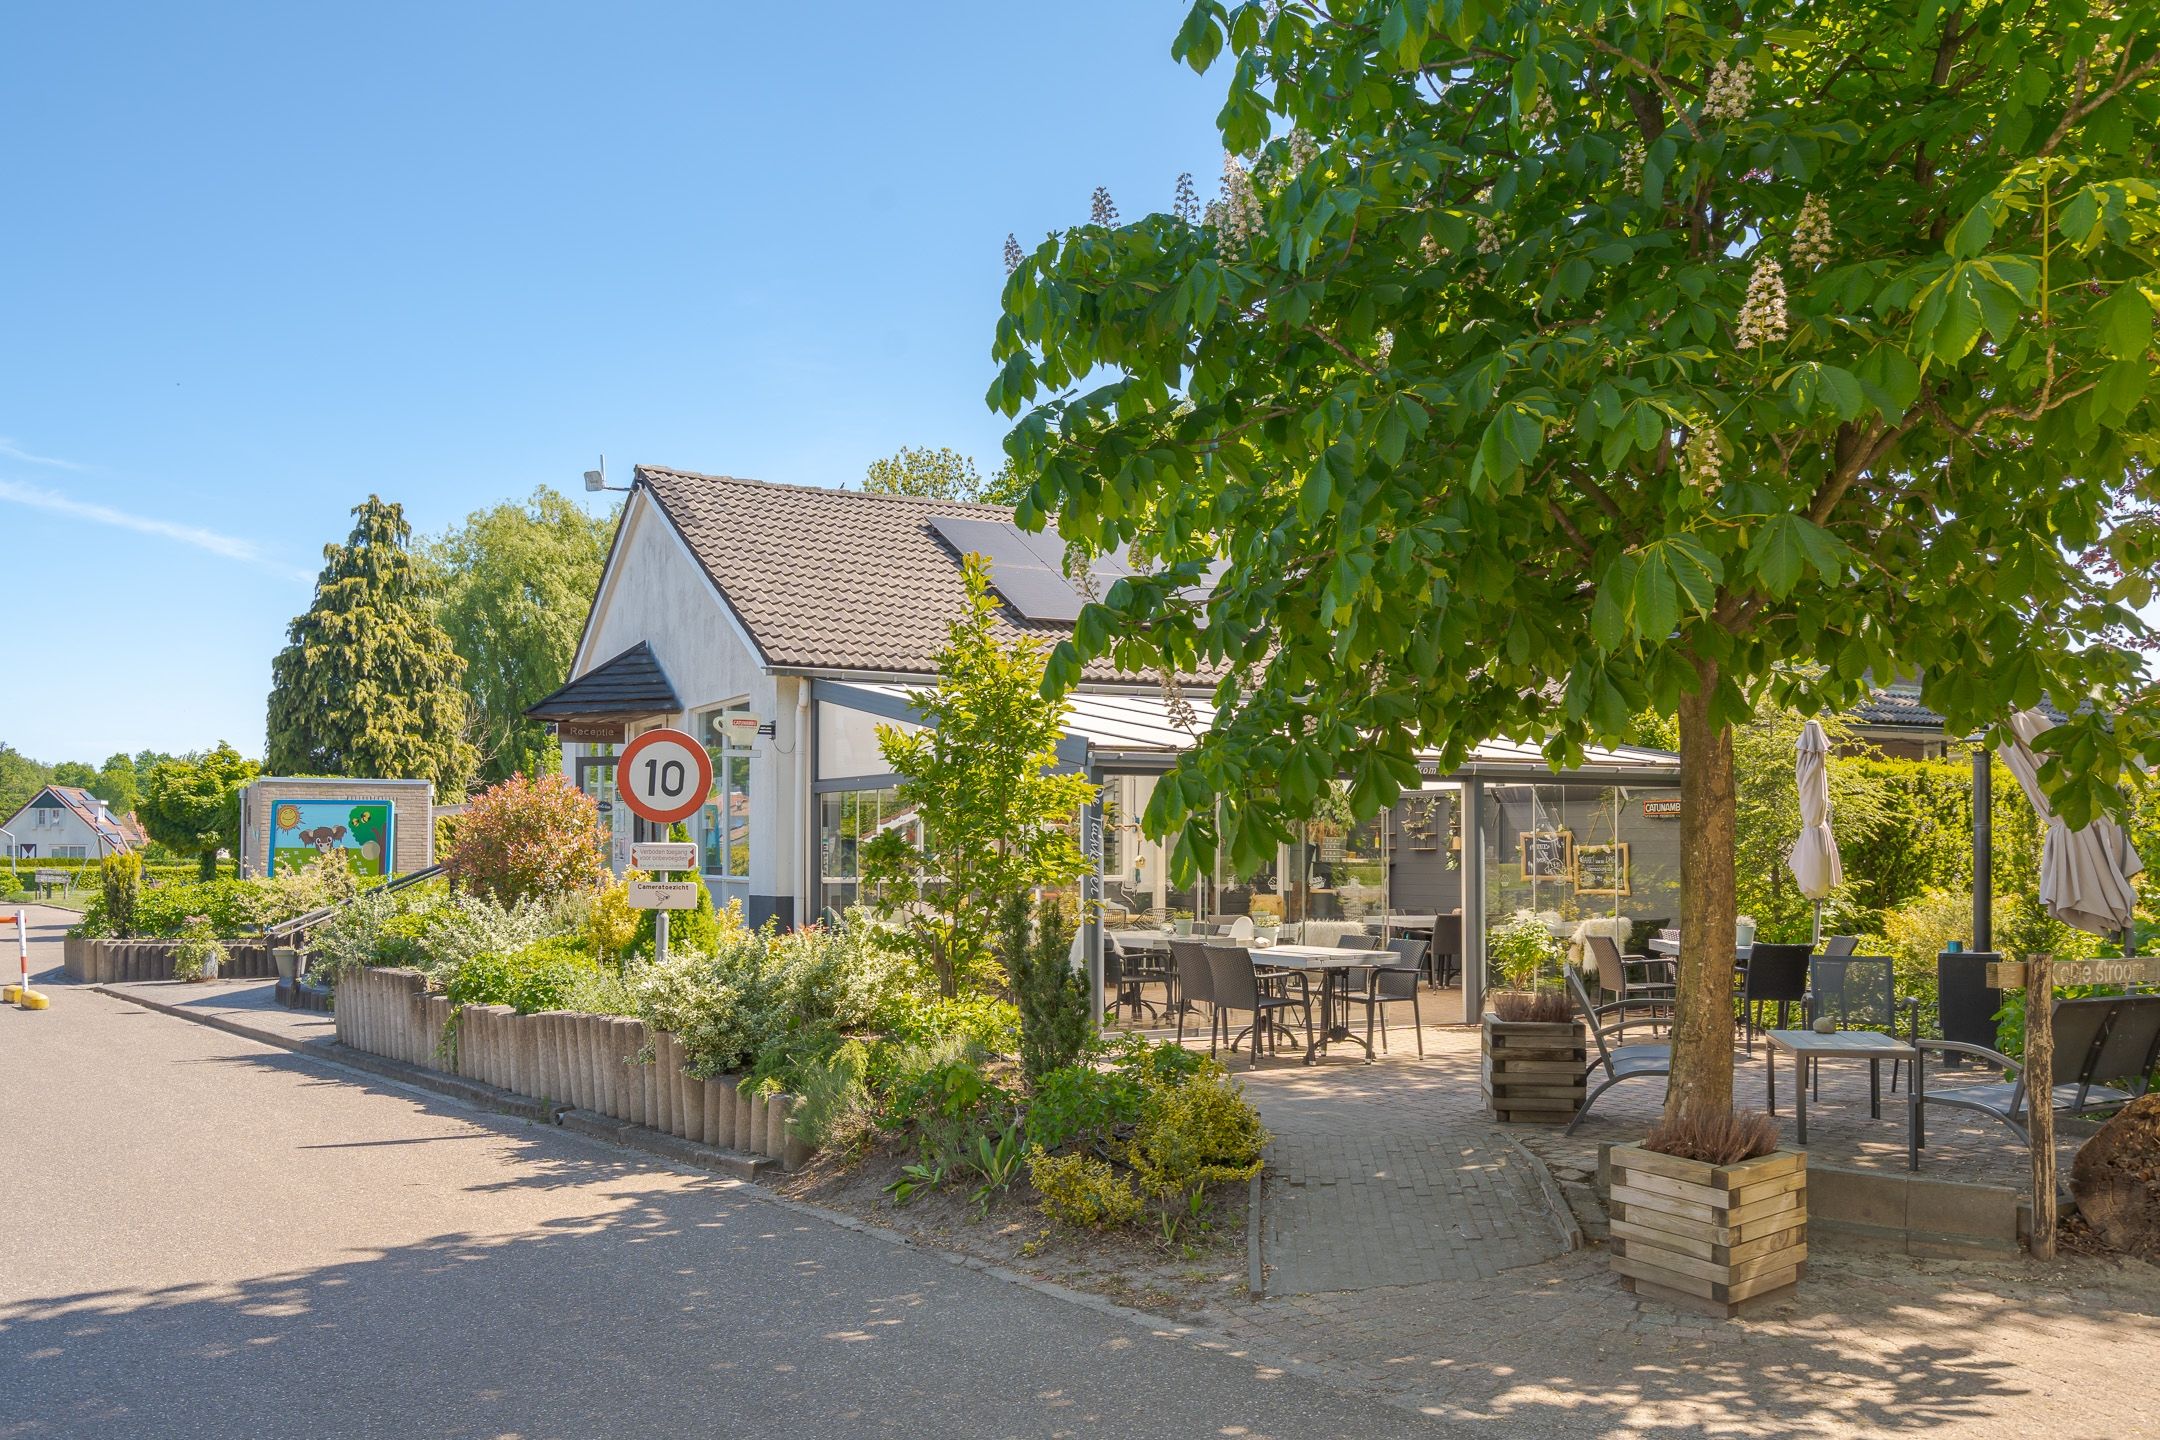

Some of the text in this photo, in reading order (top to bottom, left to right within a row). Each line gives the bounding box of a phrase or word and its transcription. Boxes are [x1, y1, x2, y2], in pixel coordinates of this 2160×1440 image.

[570, 727, 615, 738] Receptie
[1417, 765, 1437, 775] kom
[645, 759, 685, 797] 10
[1645, 802, 1681, 813] CATUNAMB
[667, 848, 688, 856] toegang
[637, 883, 689, 891] Cameratoezicht
